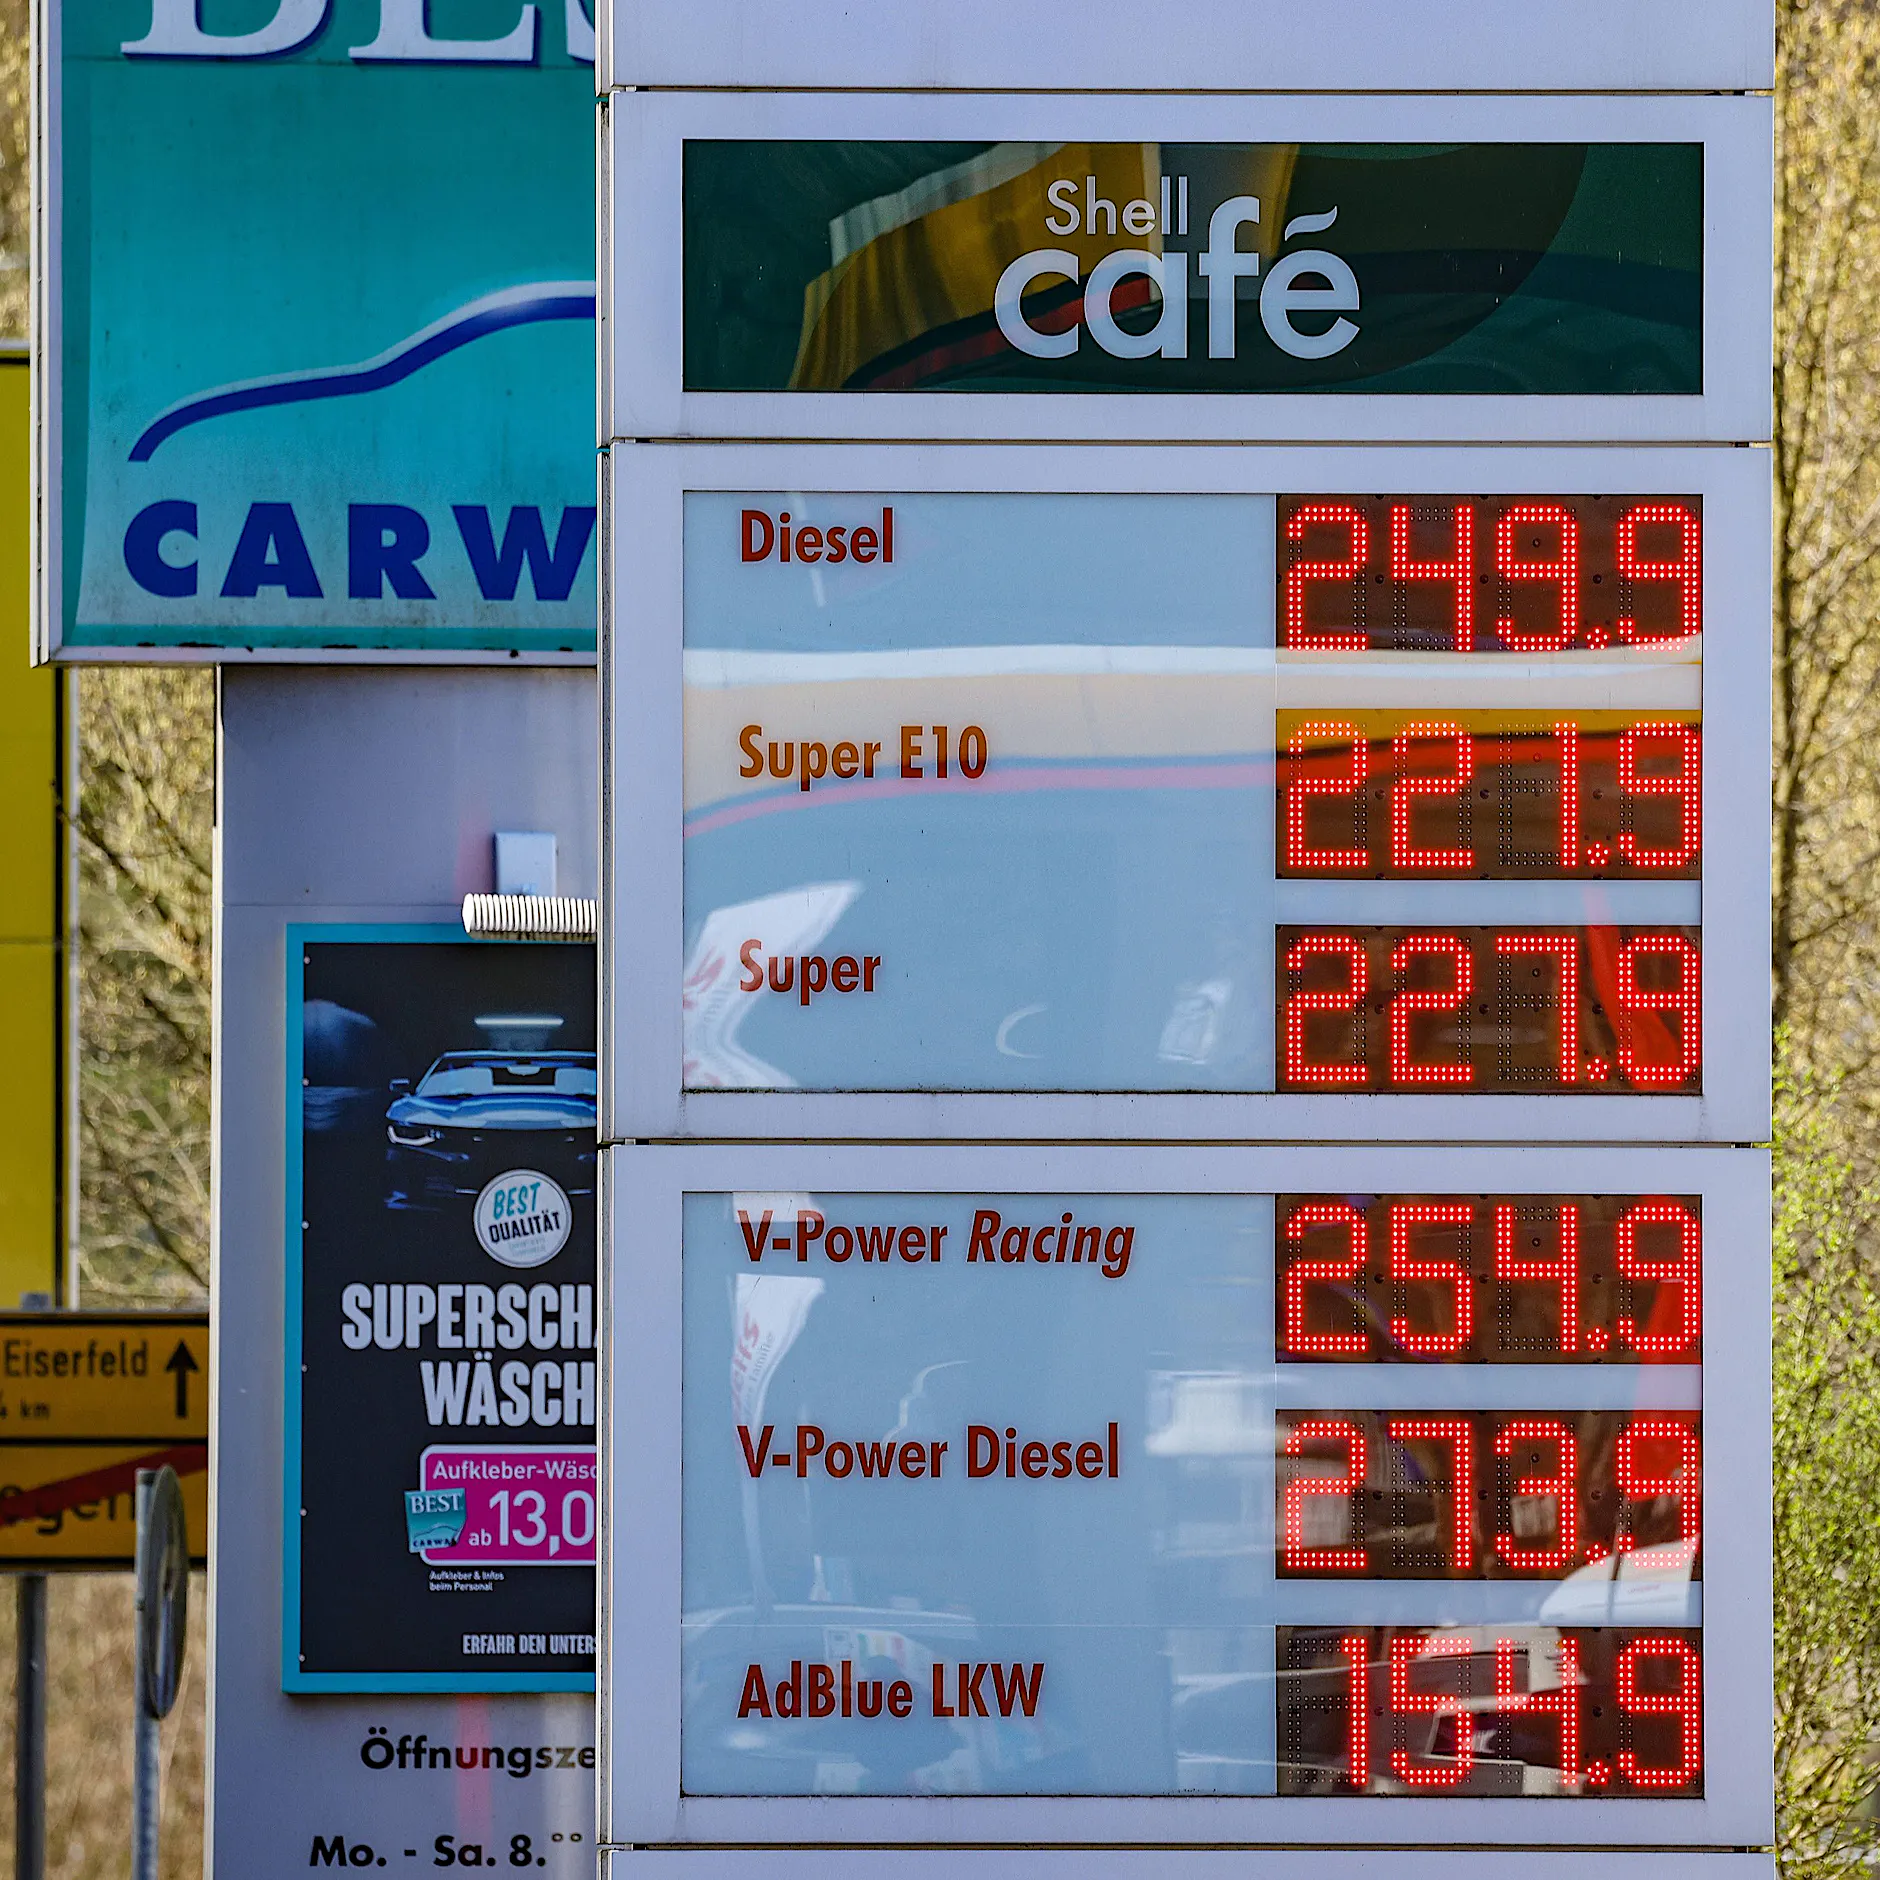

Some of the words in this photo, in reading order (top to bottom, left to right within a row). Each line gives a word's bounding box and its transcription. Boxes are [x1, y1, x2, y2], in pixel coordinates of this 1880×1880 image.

[1046, 176, 1188, 236] Shell
[995, 196, 1360, 359] café
[123, 499, 595, 601] CARW
[741, 507, 893, 563] Diesel
[1287, 505, 1700, 652] 249.9
[739, 724, 881, 791] Super
[900, 725, 988, 779] E10
[1287, 722, 1700, 868] 221.9
[739, 938, 881, 1006] Super
[1287, 936, 1699, 1083] 227.9
[488, 1209, 560, 1243] QUALITÄT
[493, 1182, 541, 1220] BEST
[737, 1210, 948, 1263] V-Power
[967, 1210, 1136, 1279] Racing
[1287, 1205, 1699, 1353] 254.9
[341, 1283, 595, 1350] SUPERSCH
[4, 1340, 147, 1377] Eiserfeld
[420, 1351, 595, 1426] WÄSCH
[737, 1425, 948, 1478] V-Power
[967, 1422, 1119, 1478] Diesel
[410, 1492, 462, 1514] BEST
[468, 1528, 491, 1546] ab
[489, 1489, 595, 1557] 13,0
[1286, 1420, 1699, 1568] 273.9
[429, 1570, 472, 1580] Aufkleber
[454, 1582, 493, 1591] Personal
[463, 1634, 515, 1654] ERFAHR
[519, 1634, 546, 1654] DEN
[737, 1660, 913, 1718] AdBlue
[932, 1663, 1044, 1717] LKW
[1342, 1638, 1700, 1786] 154.9
[360, 1726, 595, 1778] Öffnungsze
[309, 1835, 387, 1867] Mo.
[433, 1834, 497, 1867] Sa.
